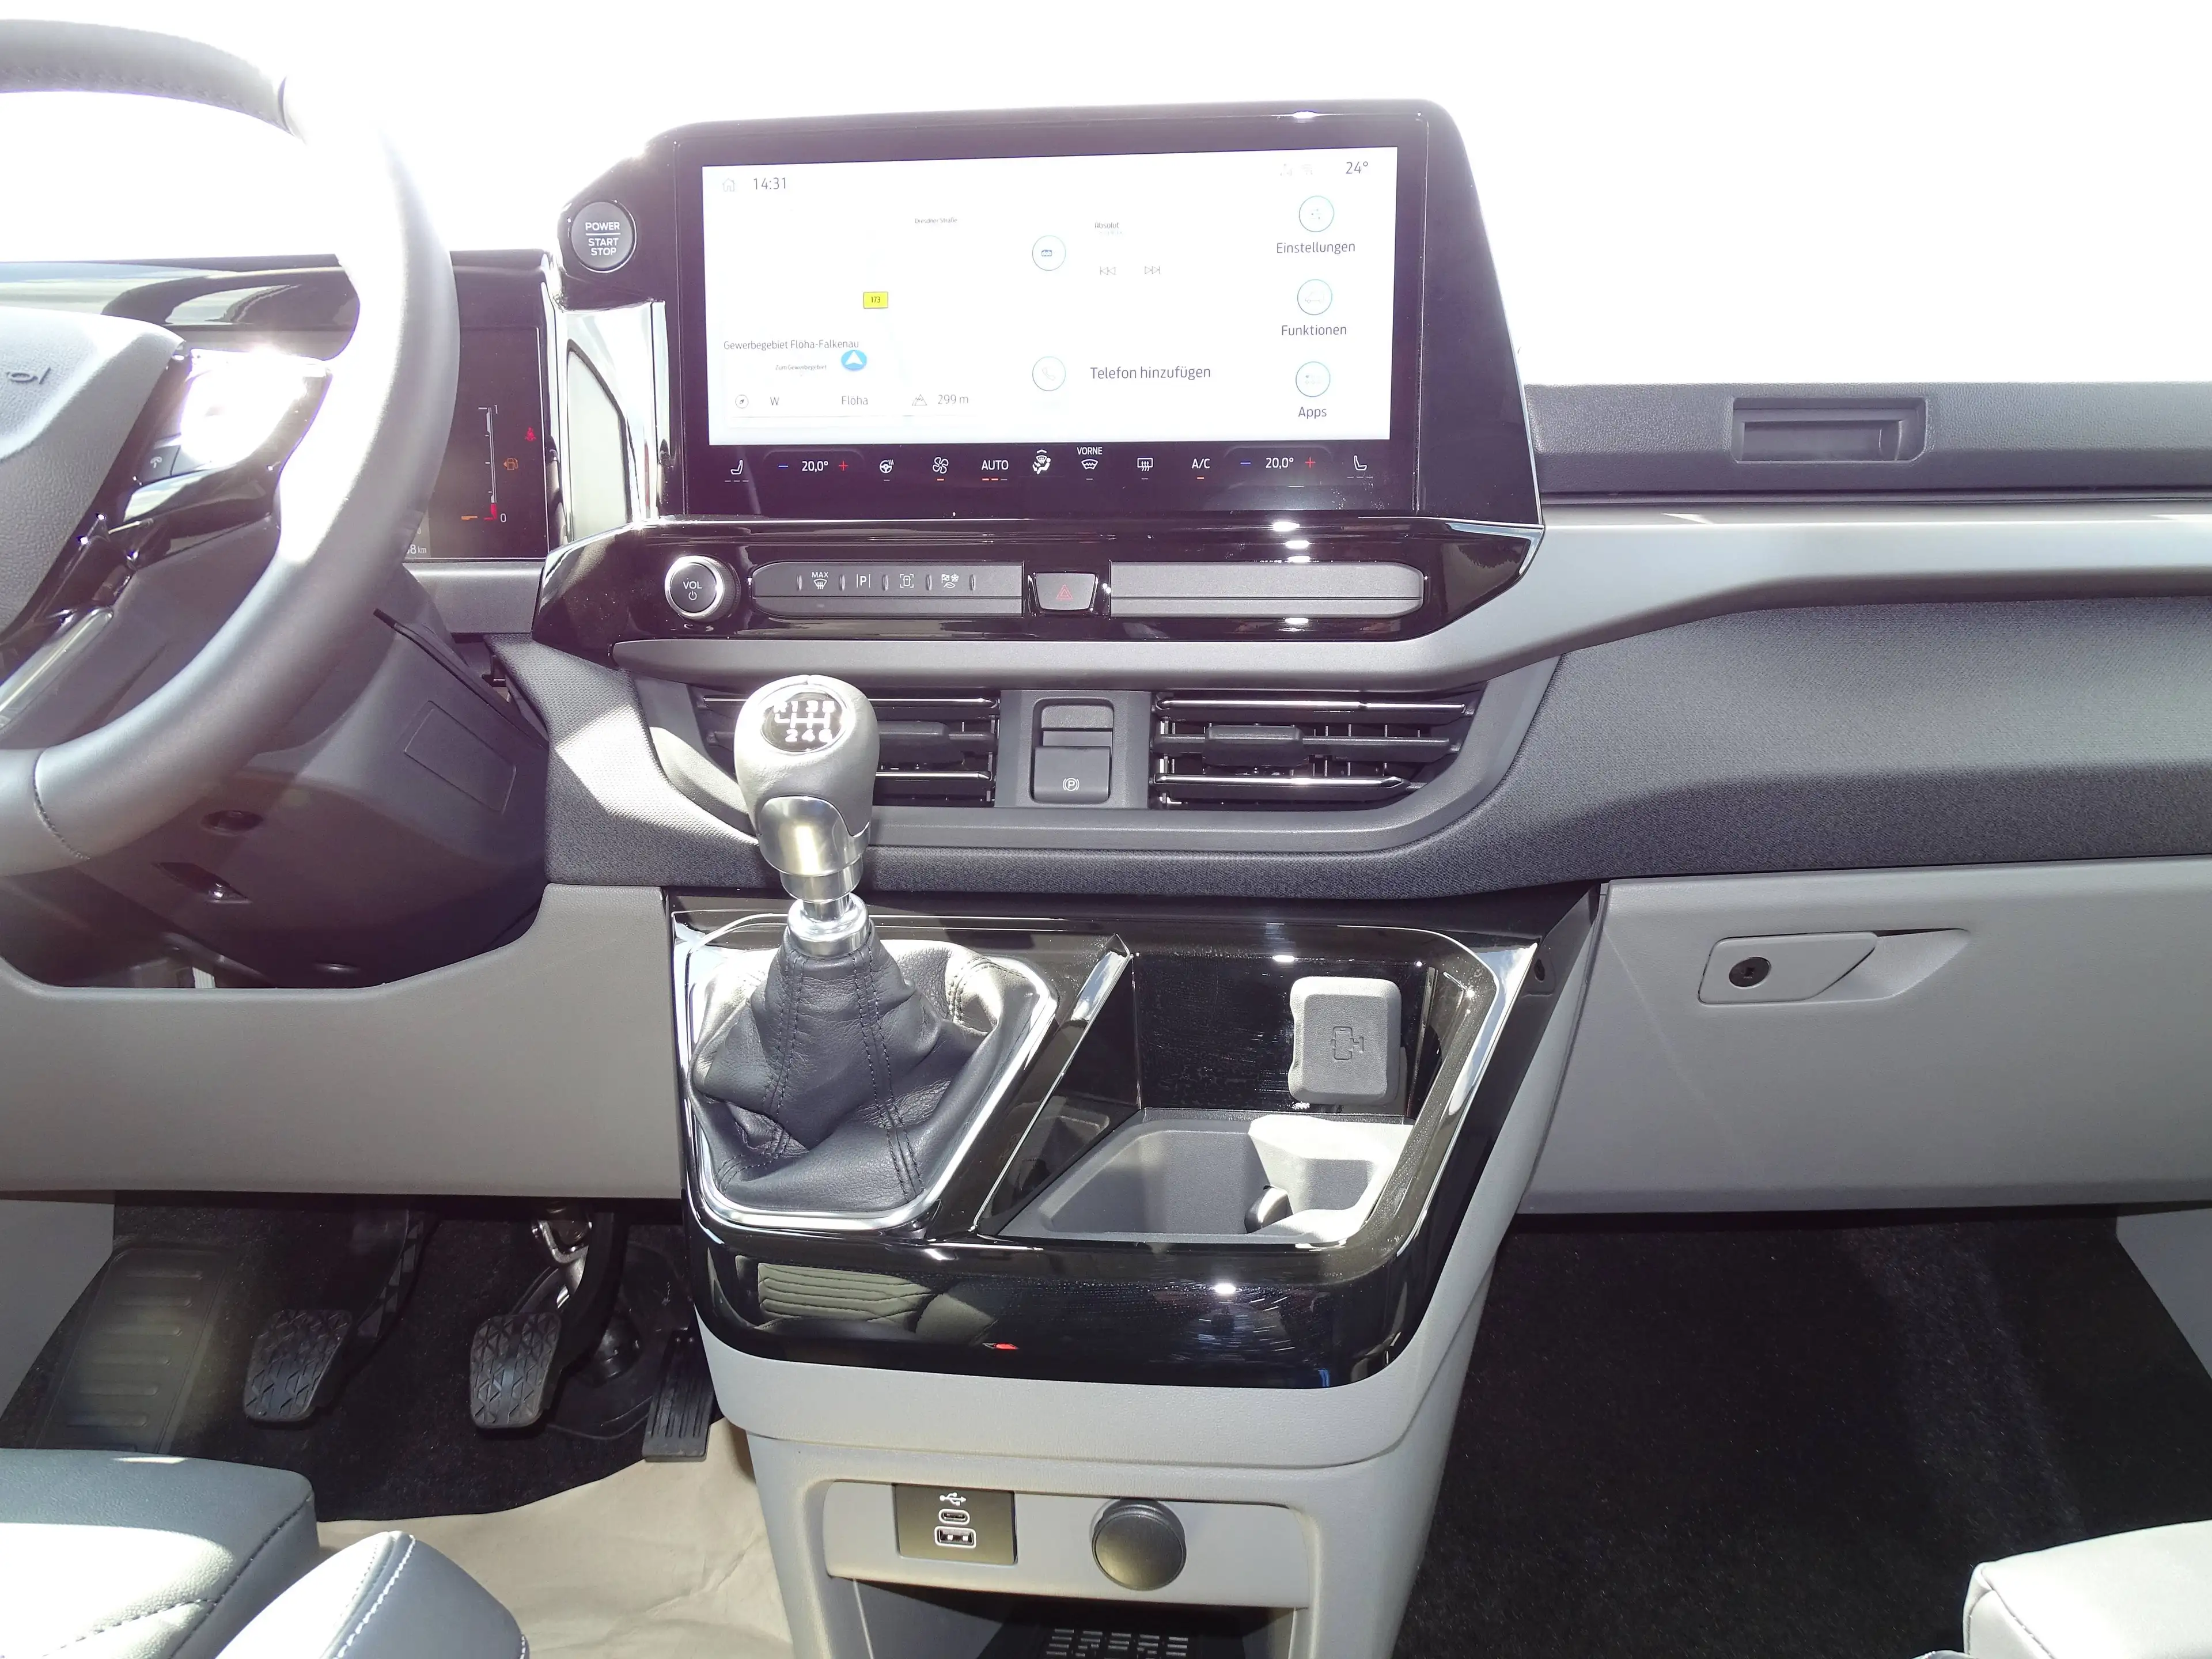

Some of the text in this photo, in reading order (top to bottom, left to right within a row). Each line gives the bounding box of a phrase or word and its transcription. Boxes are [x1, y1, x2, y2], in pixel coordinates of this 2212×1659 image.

[1346, 161, 1369, 175] 24°
[753, 177, 786, 191] 14:31
[585, 221, 620, 231] POWER
[588, 237, 619, 247] START
[590, 247, 617, 256] STOP
[1276, 241, 1356, 255] Einstellungen
[870, 296, 881, 304] 173
[1281, 324, 1347, 336] Funktionen
[724, 339, 788, 351] Gewerbegebiet
[1090, 365, 1211, 381] Telefon hinzufügen
[770, 396, 779, 406] W
[841, 395, 869, 406] Flöha
[937, 394, 969, 405] 299 m
[1298, 406, 1328, 420] Apps
[1077, 446, 1103, 456] VORNE
[801, 460, 829, 472] 20,0°
[981, 460, 1009, 471] AUTO
[1191, 458, 1211, 469] A/C
[1265, 456, 1294, 469] 20,0°
[500, 513, 507, 523] 0
[417, 546, 427, 554] km
[683, 581, 703, 589] VOL
[785, 729, 798, 743] 2
